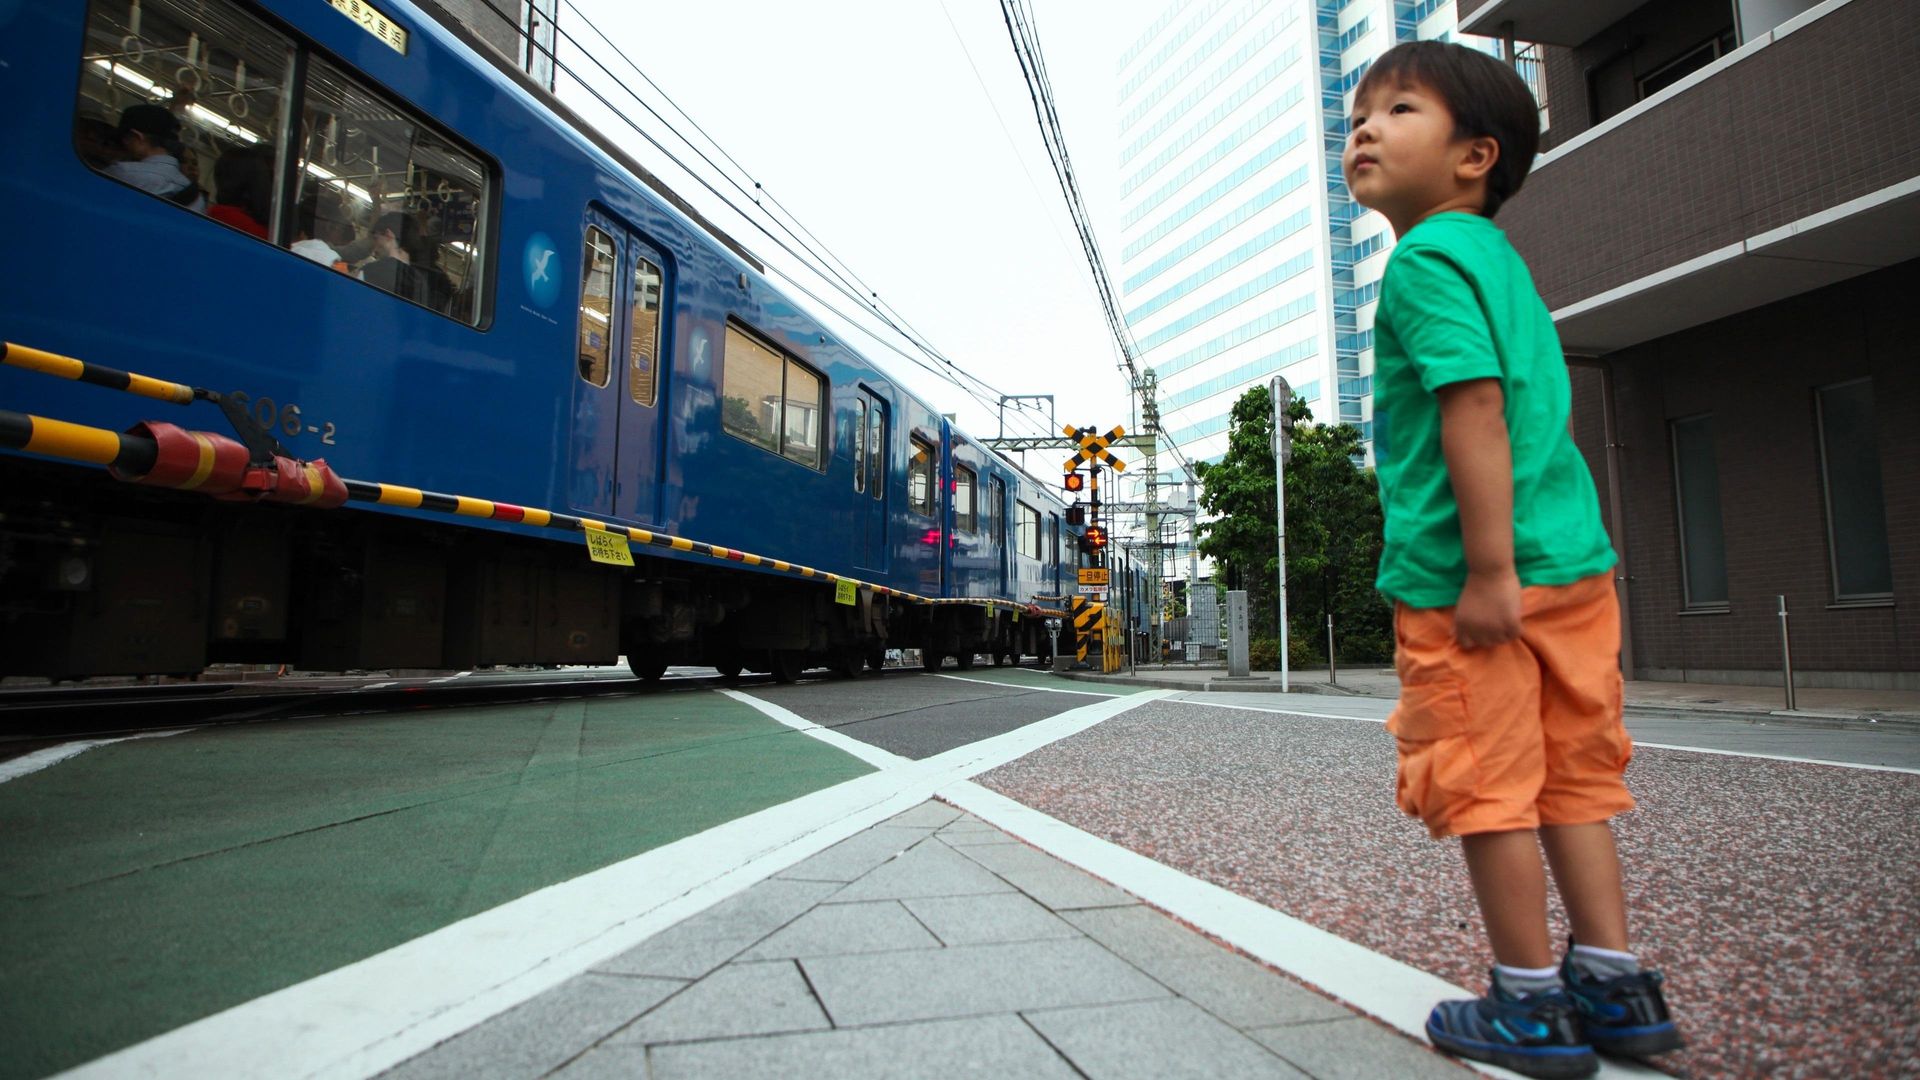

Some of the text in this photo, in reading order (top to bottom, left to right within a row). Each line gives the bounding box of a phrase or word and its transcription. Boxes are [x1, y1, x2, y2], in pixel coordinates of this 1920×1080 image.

[229, 391, 336, 445] 06-2
[590, 535, 613, 548] しばらく
[592, 547, 629, 560] お待ち下さい
[1079, 571, 1108, 581] 一旦停止
